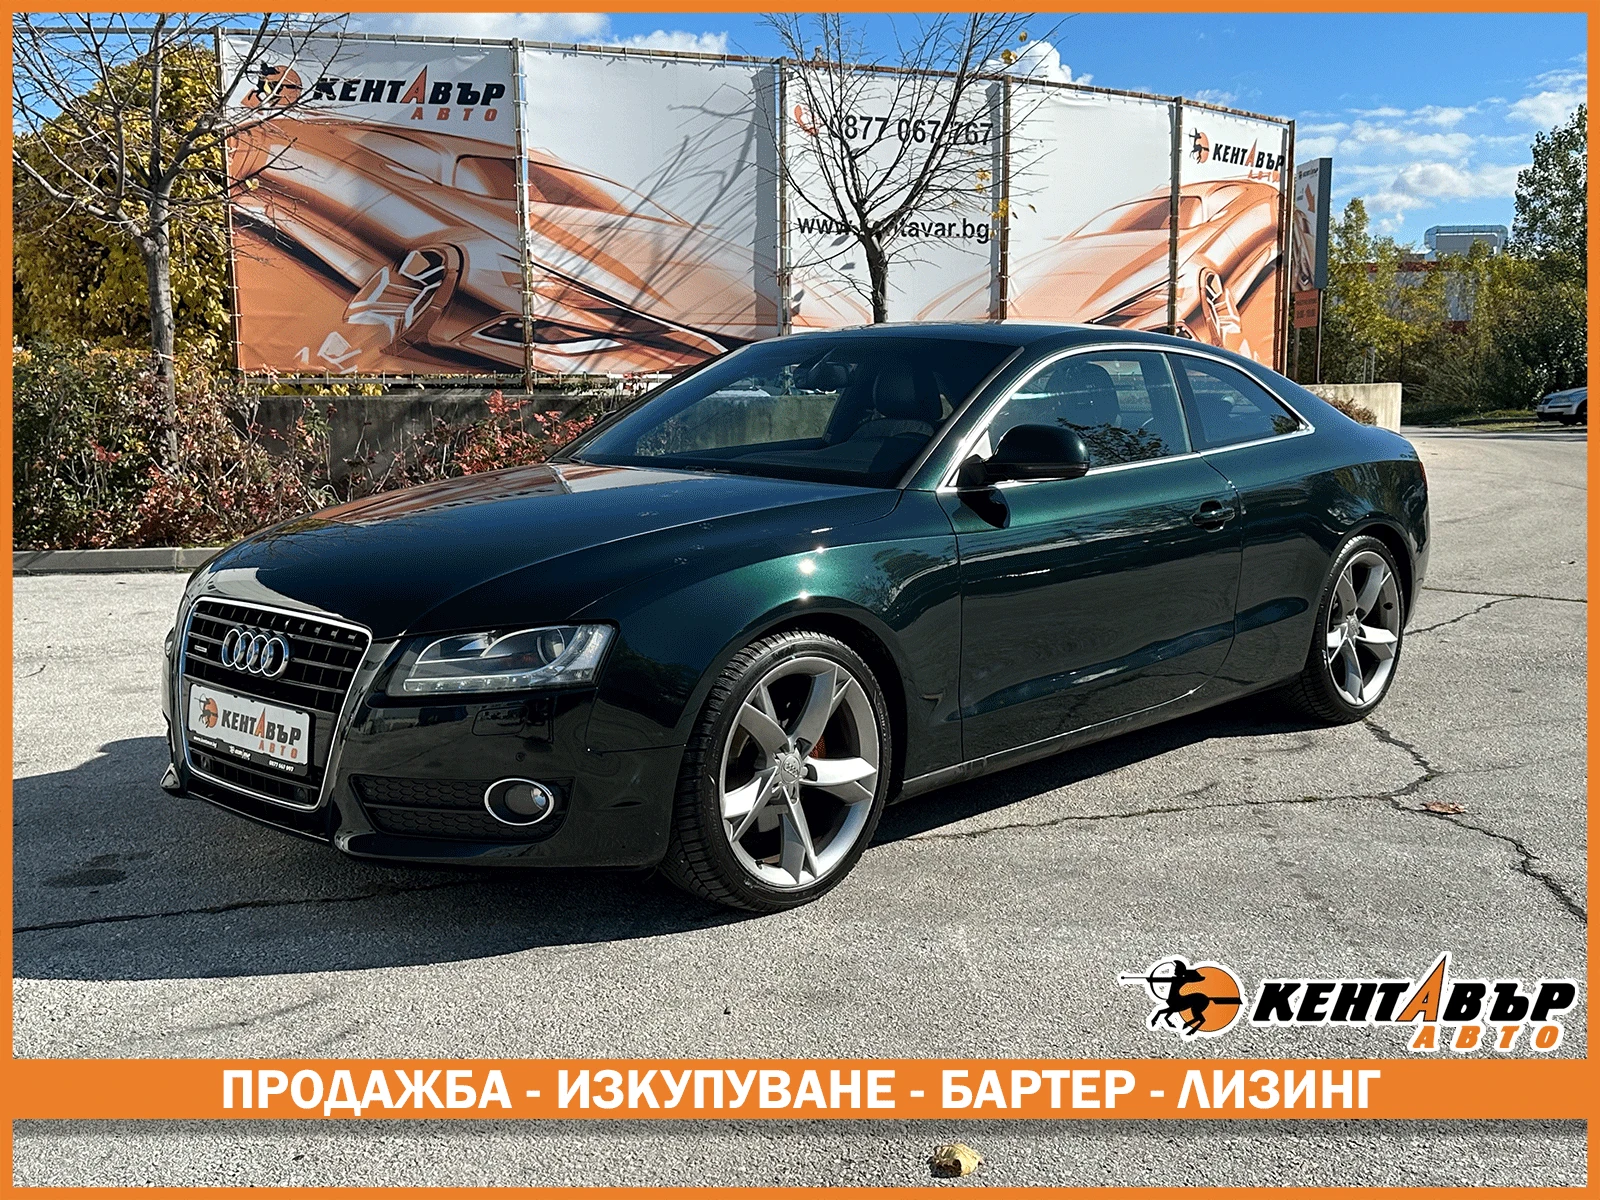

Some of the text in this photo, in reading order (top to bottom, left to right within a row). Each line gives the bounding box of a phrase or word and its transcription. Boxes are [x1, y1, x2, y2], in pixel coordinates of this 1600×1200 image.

[313, 65, 506, 105] КЕНТАВЪР
[411, 107, 498, 122] АВТО
[898, 118, 941, 144] 067
[1212, 138, 1286, 171] КЕНТАВЪР
[221, 707, 301, 746] КЕНТАВЪР
[259, 740, 298, 759] АВТО
